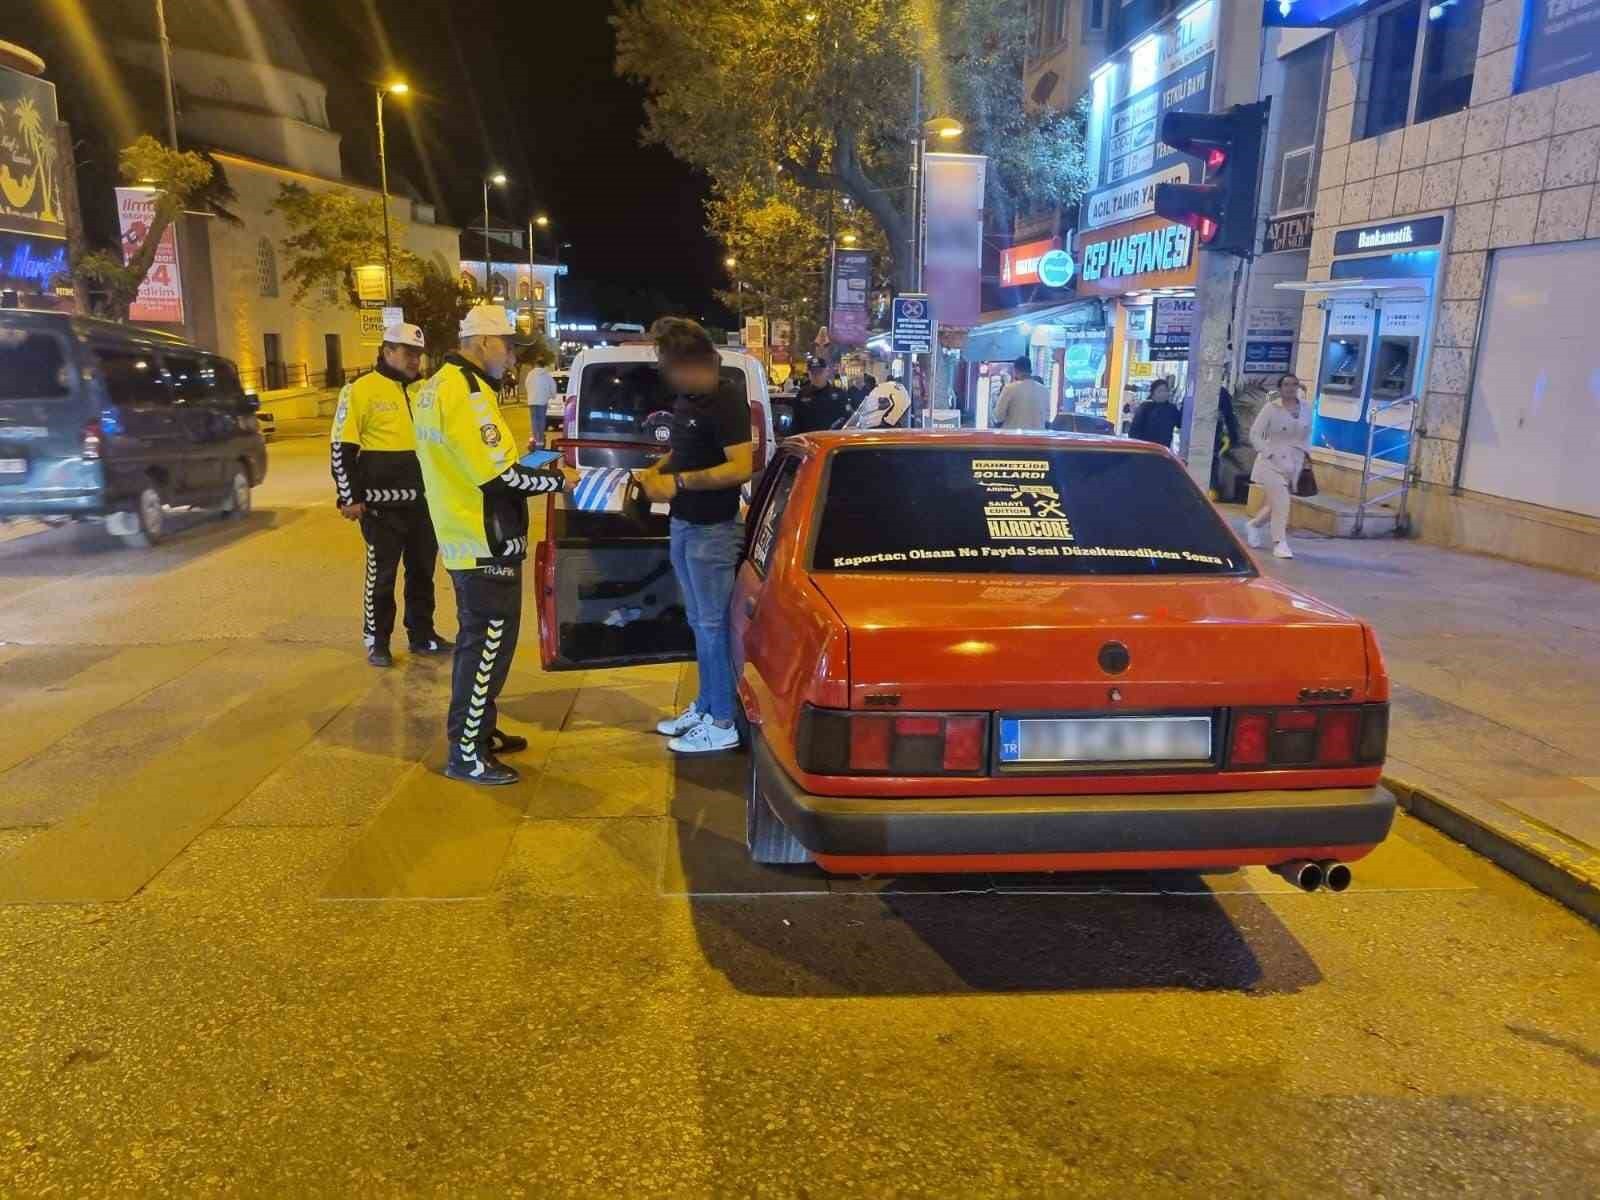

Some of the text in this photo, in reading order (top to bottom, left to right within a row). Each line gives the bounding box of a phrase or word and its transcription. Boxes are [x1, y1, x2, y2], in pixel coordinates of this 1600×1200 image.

[1112, 187, 1139, 214] TAMİR
[1358, 226, 1413, 249] Bankamatik
[1083, 241, 1107, 281] CEP
[973, 471, 1046, 480] SOLLARDI
[987, 519, 1072, 538] HARDCORE
[833, 553, 907, 568] Kaportacı
[909, 548, 957, 560] Olsam
[959, 547, 978, 557] Ne
[981, 546, 1026, 559] Fayda
[1027, 545, 1059, 557] Seni
[1182, 551, 1222, 565] Sonra
[1003, 743, 1018, 753] TR
